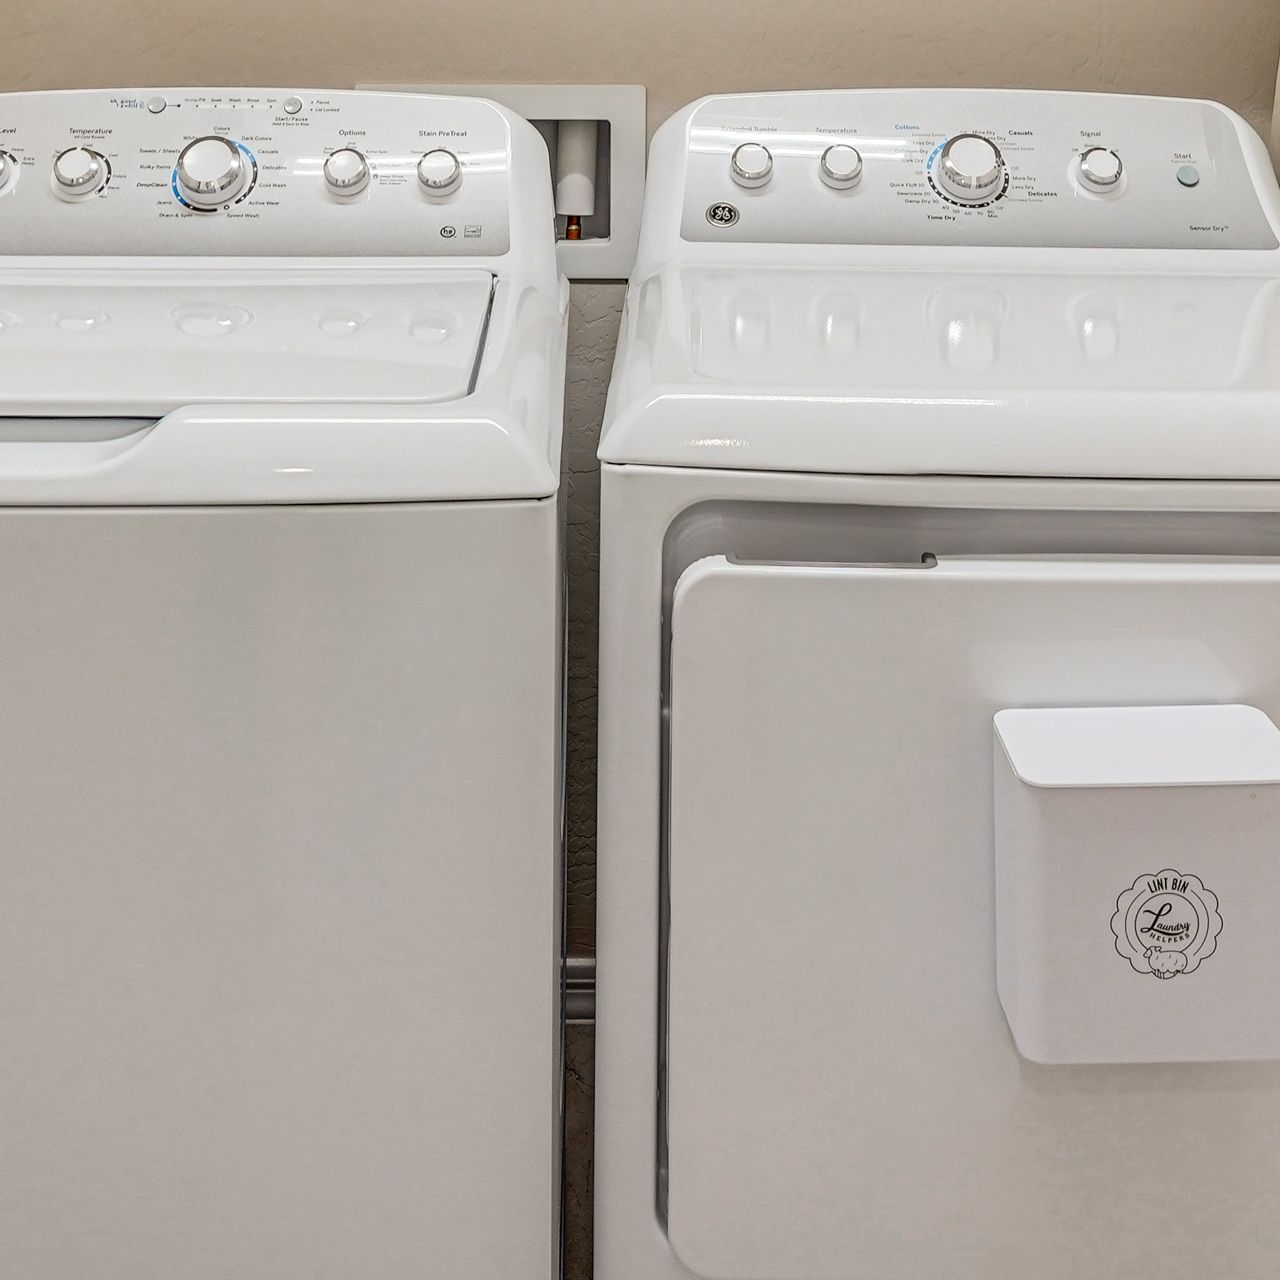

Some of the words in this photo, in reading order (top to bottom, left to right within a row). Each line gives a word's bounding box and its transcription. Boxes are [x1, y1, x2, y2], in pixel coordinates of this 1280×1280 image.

[338, 129, 366, 137] Options
[815, 126, 858, 134] Temperature
[1080, 130, 1102, 138] Signal
[1147, 877, 1169, 894] LINT
[1171, 877, 1190, 894] BIN
[1140, 902, 1191, 936] Laundry
[1149, 932, 1190, 943] HELPERS
